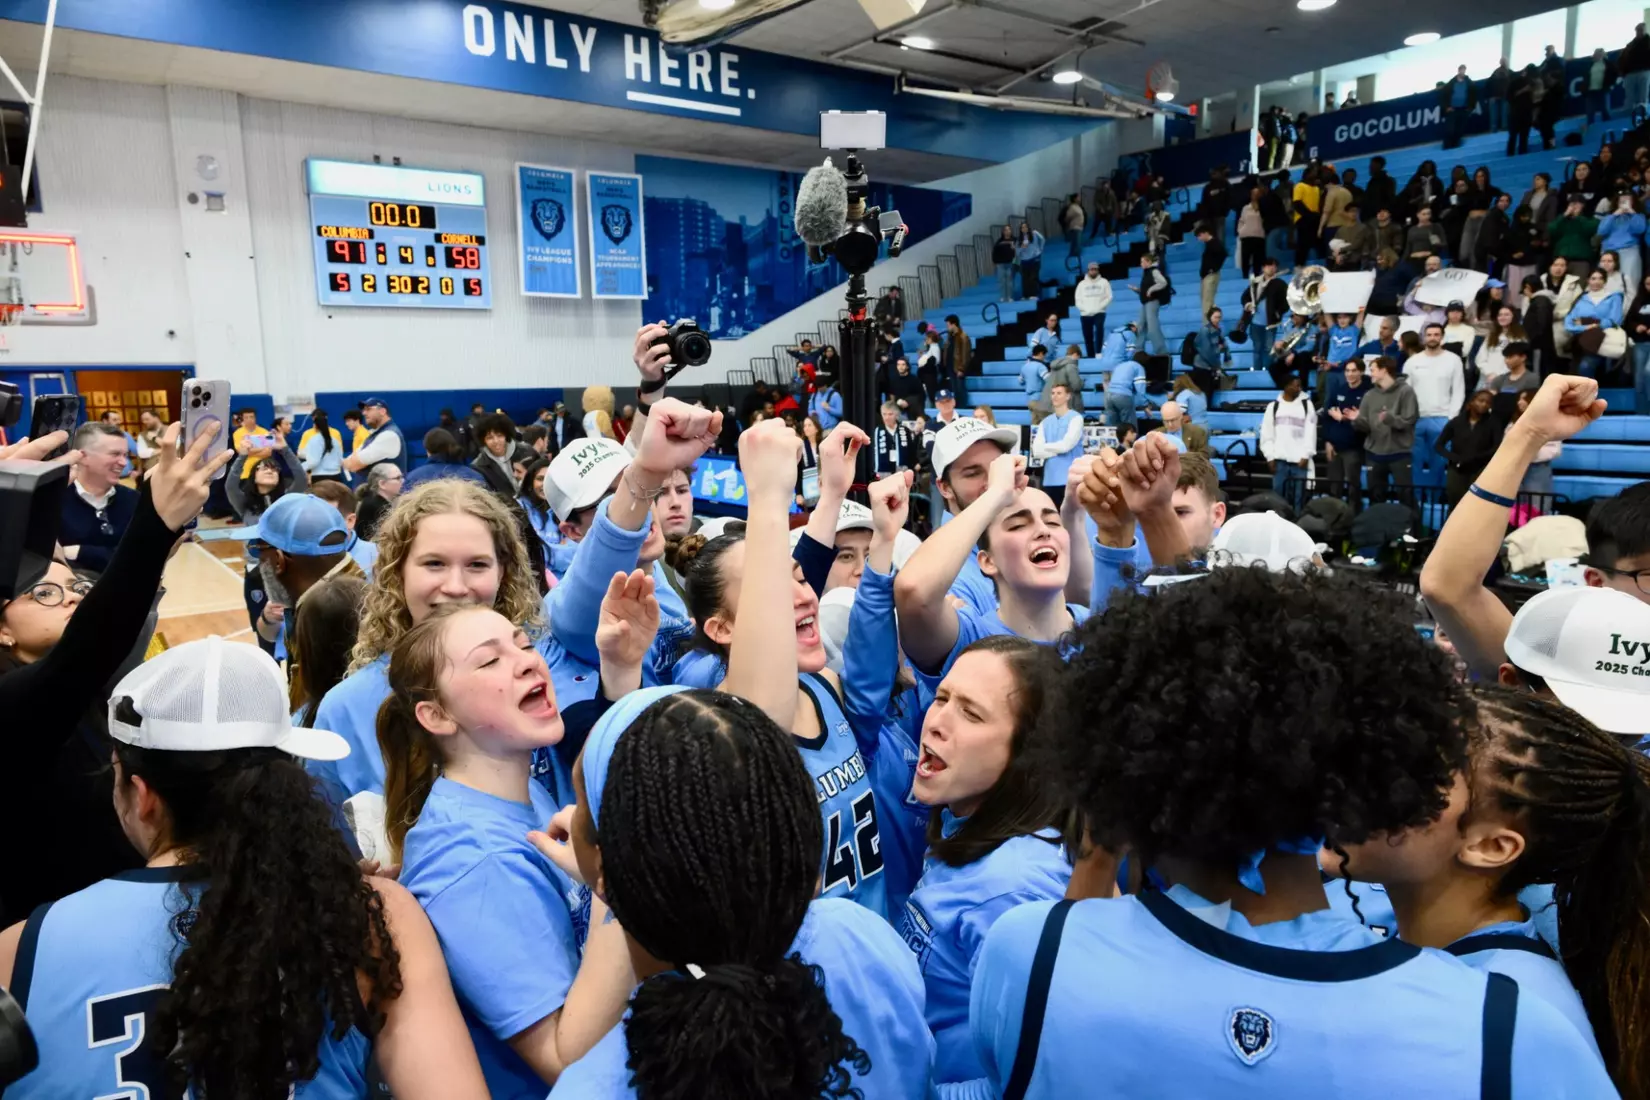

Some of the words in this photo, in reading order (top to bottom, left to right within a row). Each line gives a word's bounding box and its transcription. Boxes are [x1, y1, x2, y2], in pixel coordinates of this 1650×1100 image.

[462, 4, 597, 73] ONLY
[624, 33, 756, 99] HERE.
[427, 182, 473, 195] LIONS
[371, 202, 421, 227] 00.0
[320, 225, 370, 239] COLUMBIA
[441, 233, 480, 246] CORNELL
[334, 240, 367, 264] 91
[400, 247, 413, 264] 4
[451, 247, 480, 270] 58
[527, 254, 573, 265] CHAMPIONS
[541, 247, 572, 256] LEAGUE
[336, 272, 350, 290] 5
[363, 273, 376, 293] 2
[1444, 270, 1469, 282] GO!
[440, 277, 453, 295] 0
[469, 279, 481, 296] 5
[954, 420, 975, 433] Ivy
[571, 443, 598, 467] Ivy
[578, 461, 595, 478] 2025
[1608, 633, 1650, 665] Ivy
[1595, 660, 1629, 675] 2025
[823, 787, 885, 893] 42
